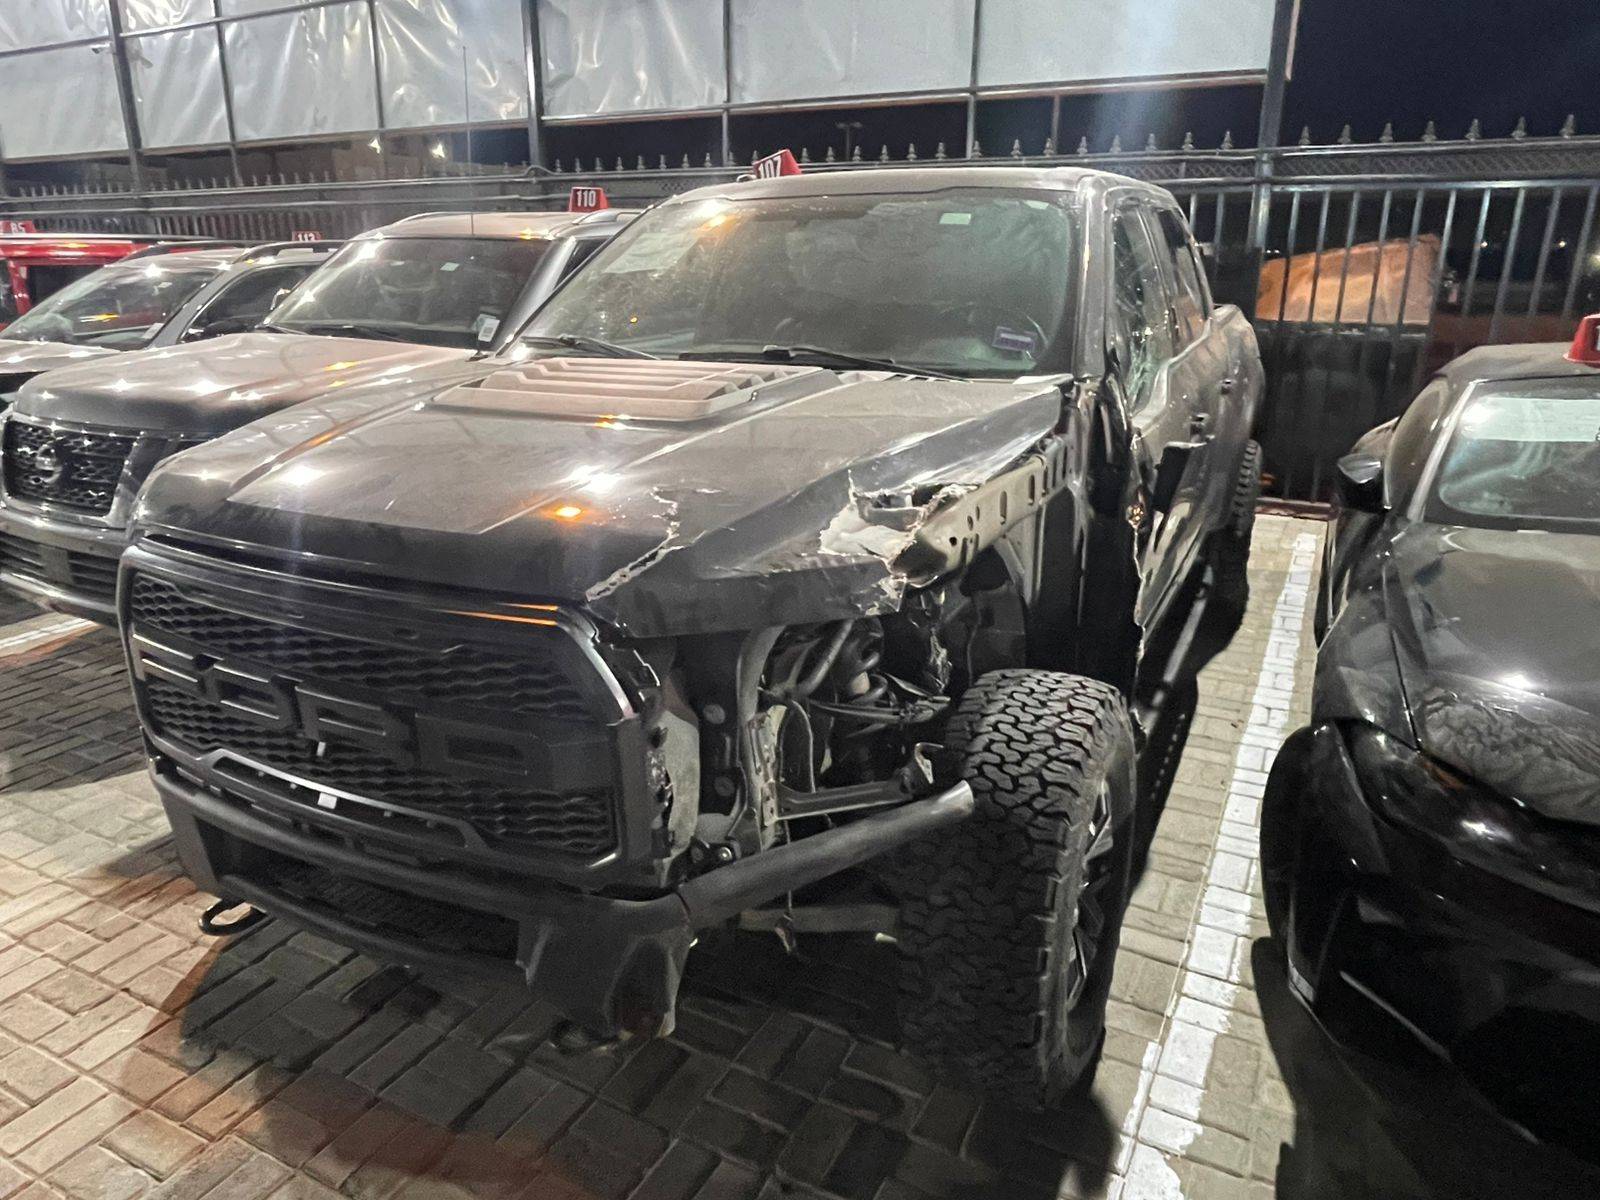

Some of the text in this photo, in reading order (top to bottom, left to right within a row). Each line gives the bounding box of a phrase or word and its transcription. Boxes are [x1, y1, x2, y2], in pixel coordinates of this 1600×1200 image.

[758, 154, 782, 179] 107
[576, 190, 597, 207] 110
[130, 632, 550, 788] FORD
